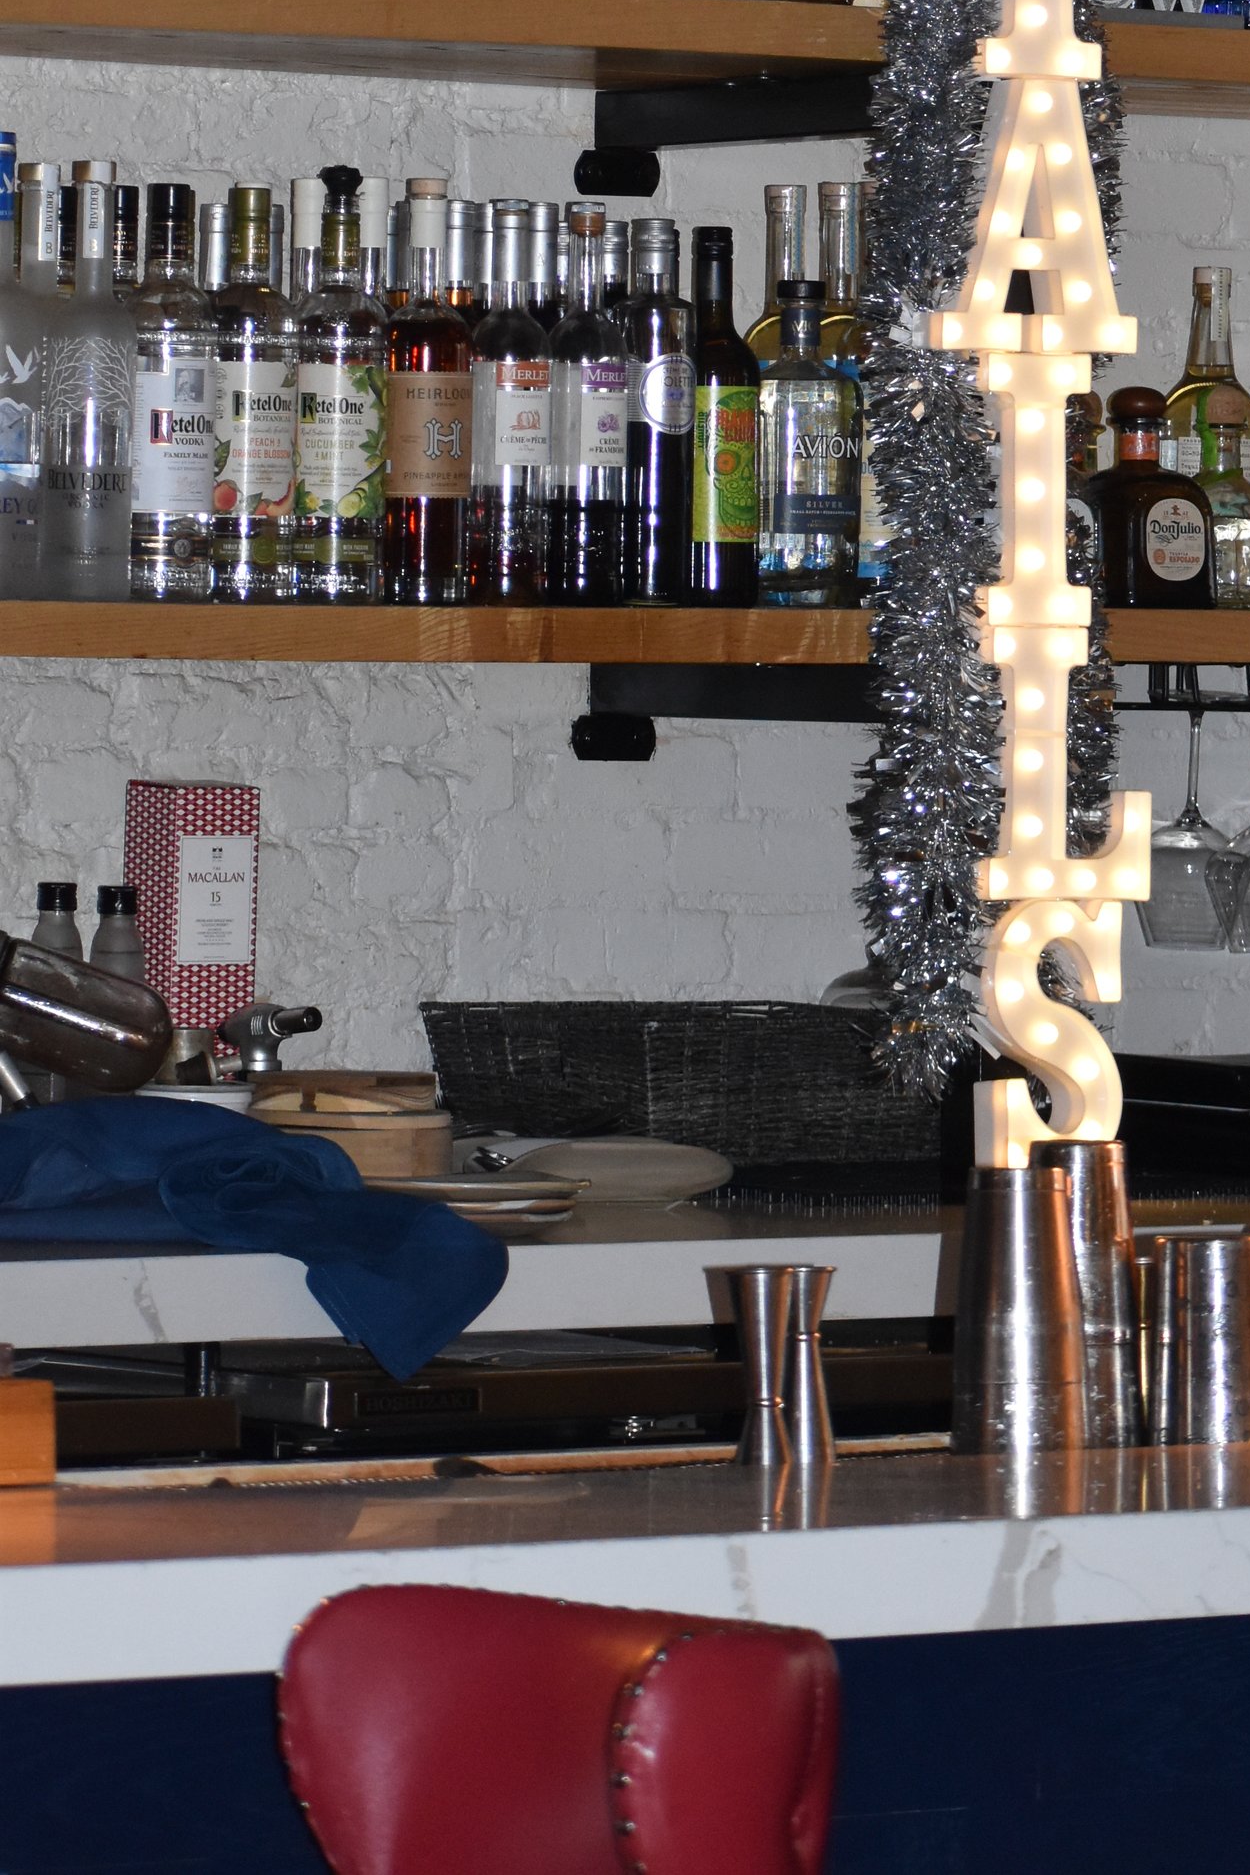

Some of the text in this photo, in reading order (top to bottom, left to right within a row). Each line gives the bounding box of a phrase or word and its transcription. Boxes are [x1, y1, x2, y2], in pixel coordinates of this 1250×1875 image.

[502, 365, 549, 381] MERLET
[273, 395, 292, 412] One
[302, 396, 364, 422] Ketel One
[174, 437, 204, 446] VODKA
[250, 437, 274, 447] PEACH
[793, 431, 860, 459] AVIÓN
[264, 449, 290, 459] BLOSSOM
[48, 468, 127, 493] BELVEDERE
[404, 472, 450, 480] PINEAPPLE
[806, 501, 844, 509] SILVER
[1150, 520, 1202, 539] Don Julio
[188, 872, 246, 883] MACALLAN
[210, 891, 221, 903] 15
